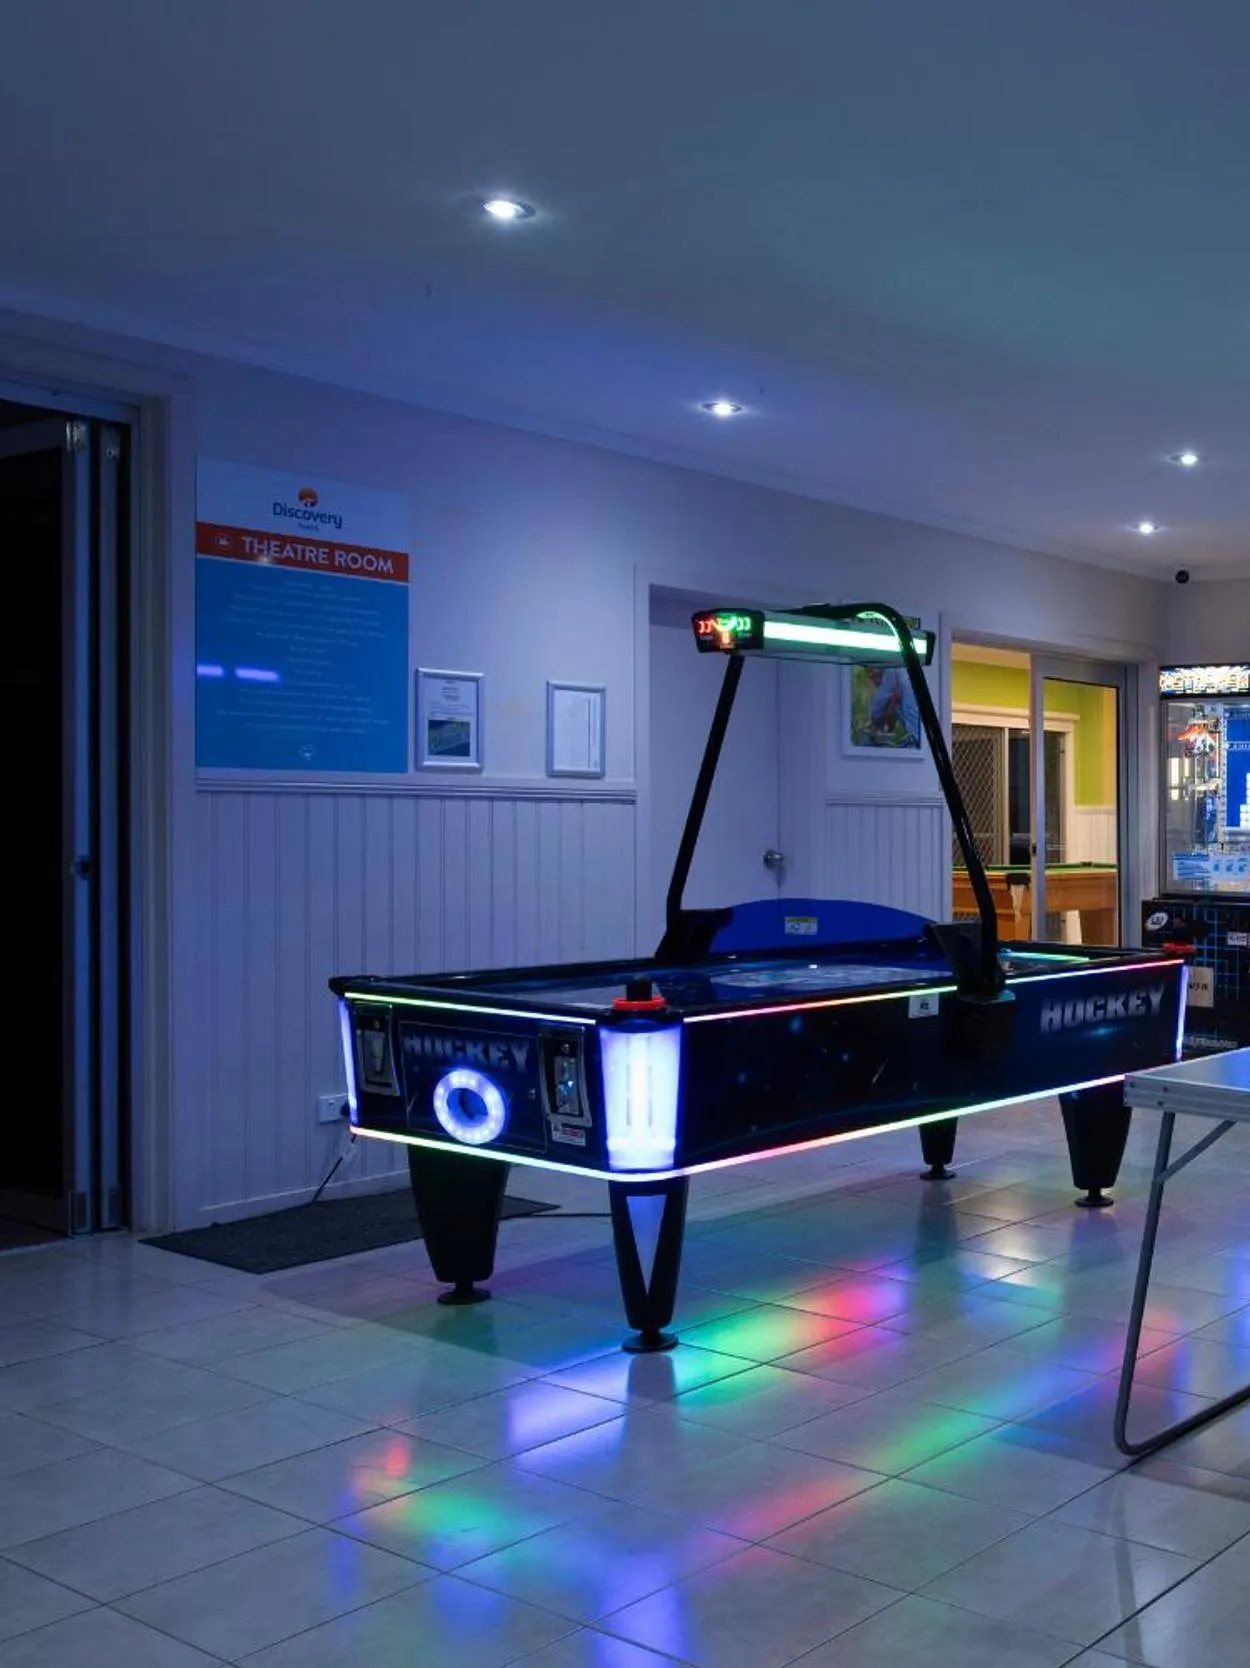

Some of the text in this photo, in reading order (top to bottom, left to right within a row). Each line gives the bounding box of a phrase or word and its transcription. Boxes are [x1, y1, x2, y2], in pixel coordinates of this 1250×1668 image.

[272, 502, 342, 529] Discovery
[241, 536, 394, 573] THEATRE ROOM
[1041, 985, 1164, 1031] HOCKEY
[403, 1035, 530, 1072] HOCKEY
